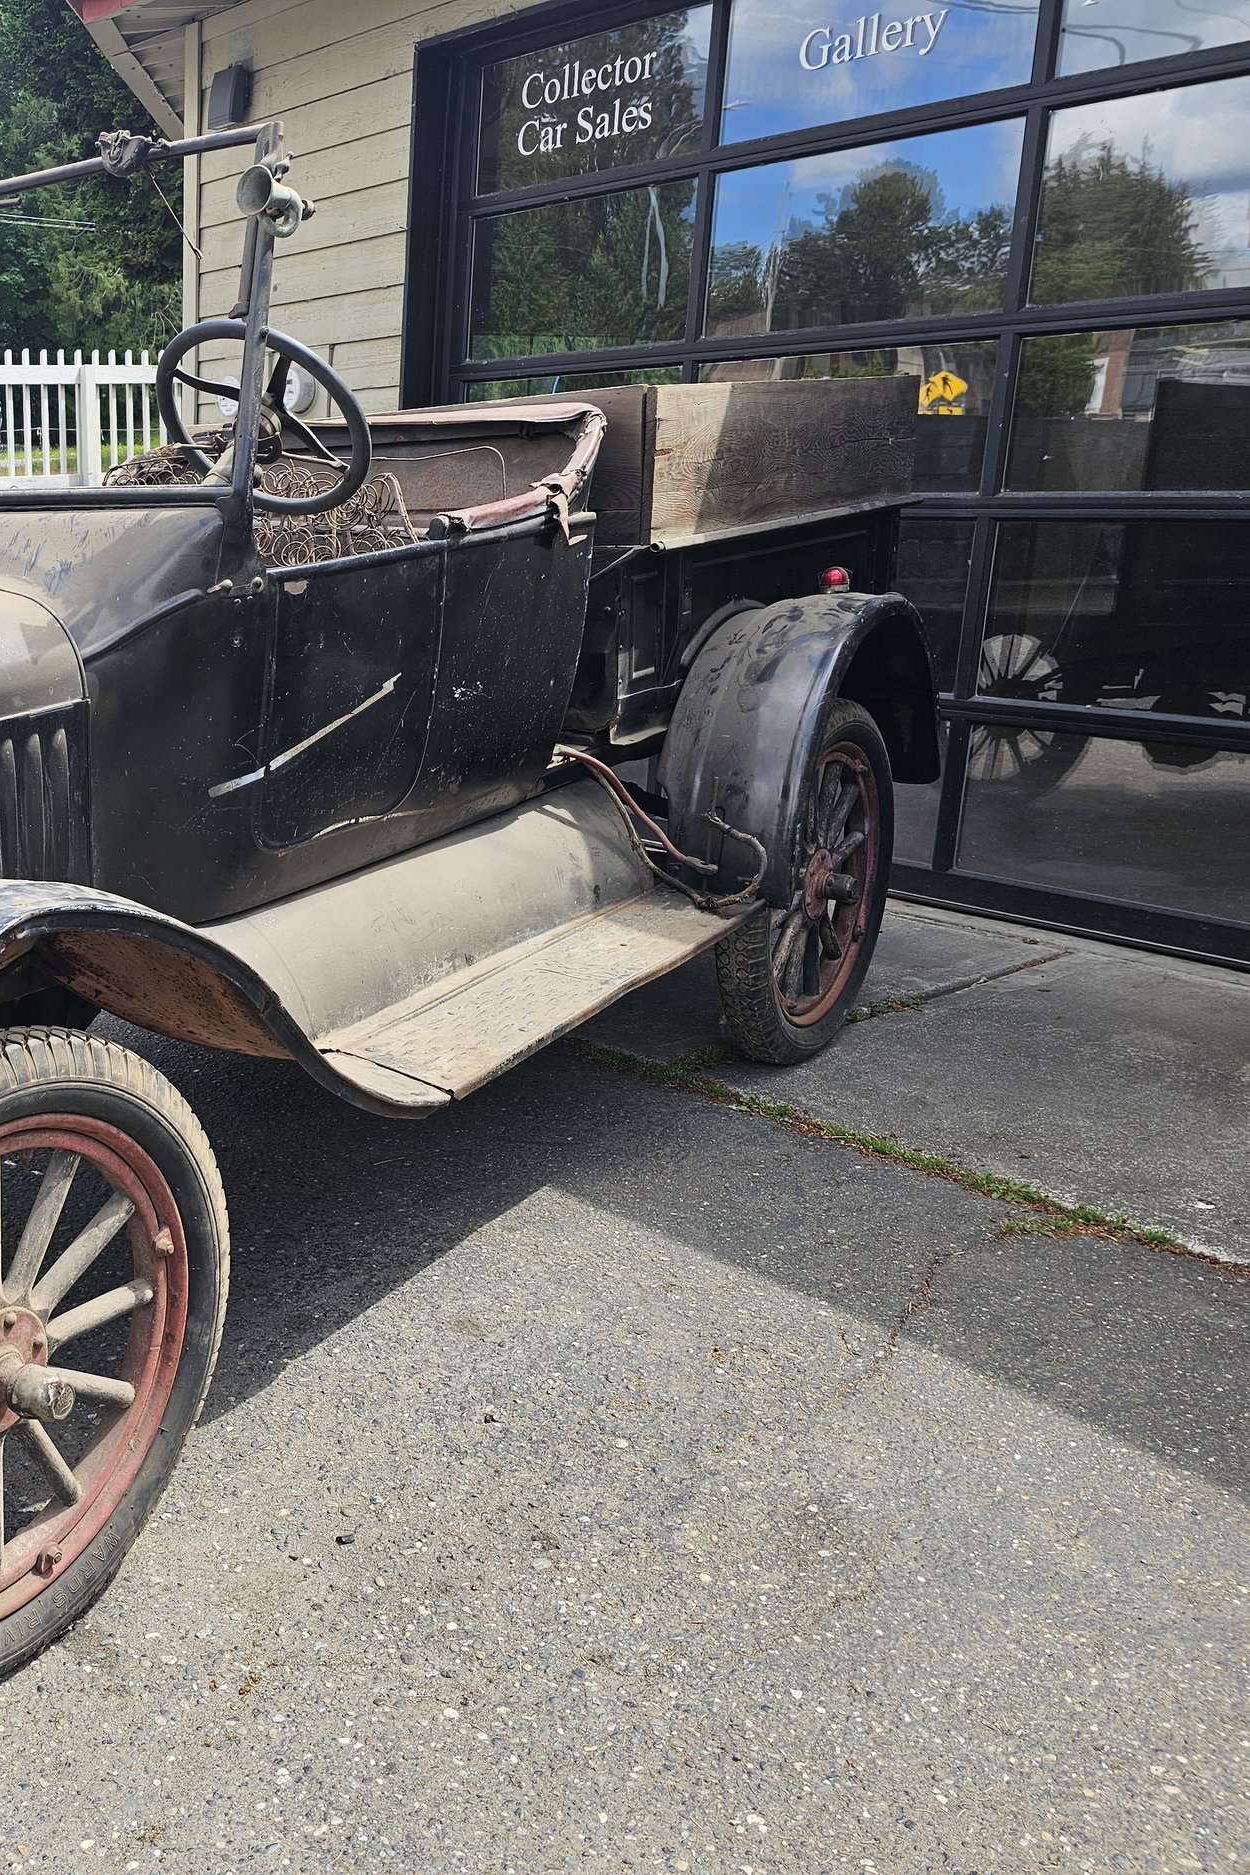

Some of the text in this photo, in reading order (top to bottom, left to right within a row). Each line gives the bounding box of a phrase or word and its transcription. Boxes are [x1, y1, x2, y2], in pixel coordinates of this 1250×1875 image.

[799, 8, 949, 71] Gallery
[521, 51, 657, 109] Collector
[517, 98, 653, 156] Car Sales
[52, 1530, 121, 1608] WARDS
